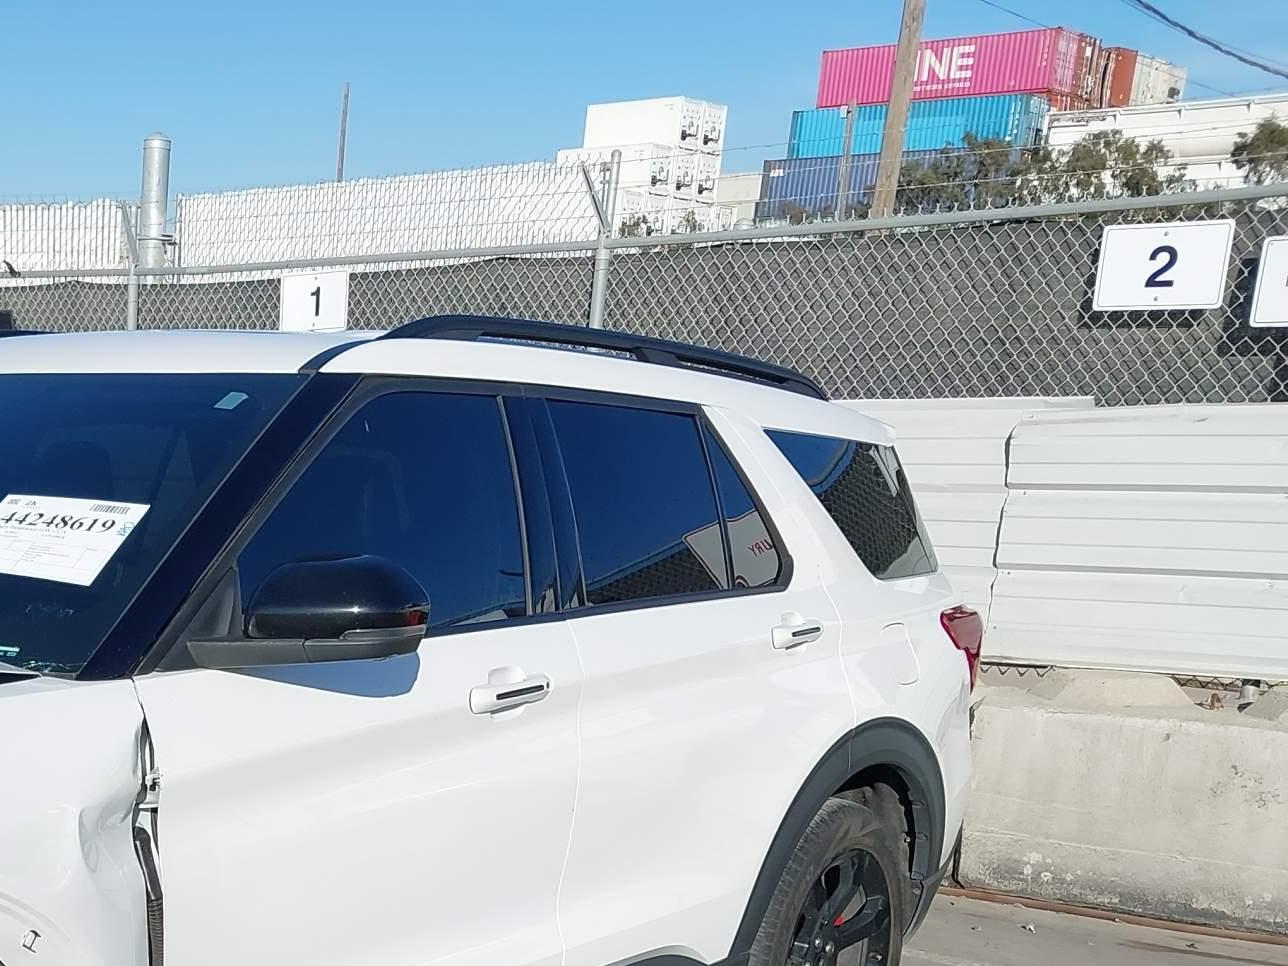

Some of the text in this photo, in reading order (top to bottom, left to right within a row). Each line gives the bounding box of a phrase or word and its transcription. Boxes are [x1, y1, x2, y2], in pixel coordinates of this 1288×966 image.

[914, 45, 975, 82] NE
[1144, 245, 1179, 288] 2
[310, 286, 321, 317] 1
[0, 511, 116, 533] 44248619
